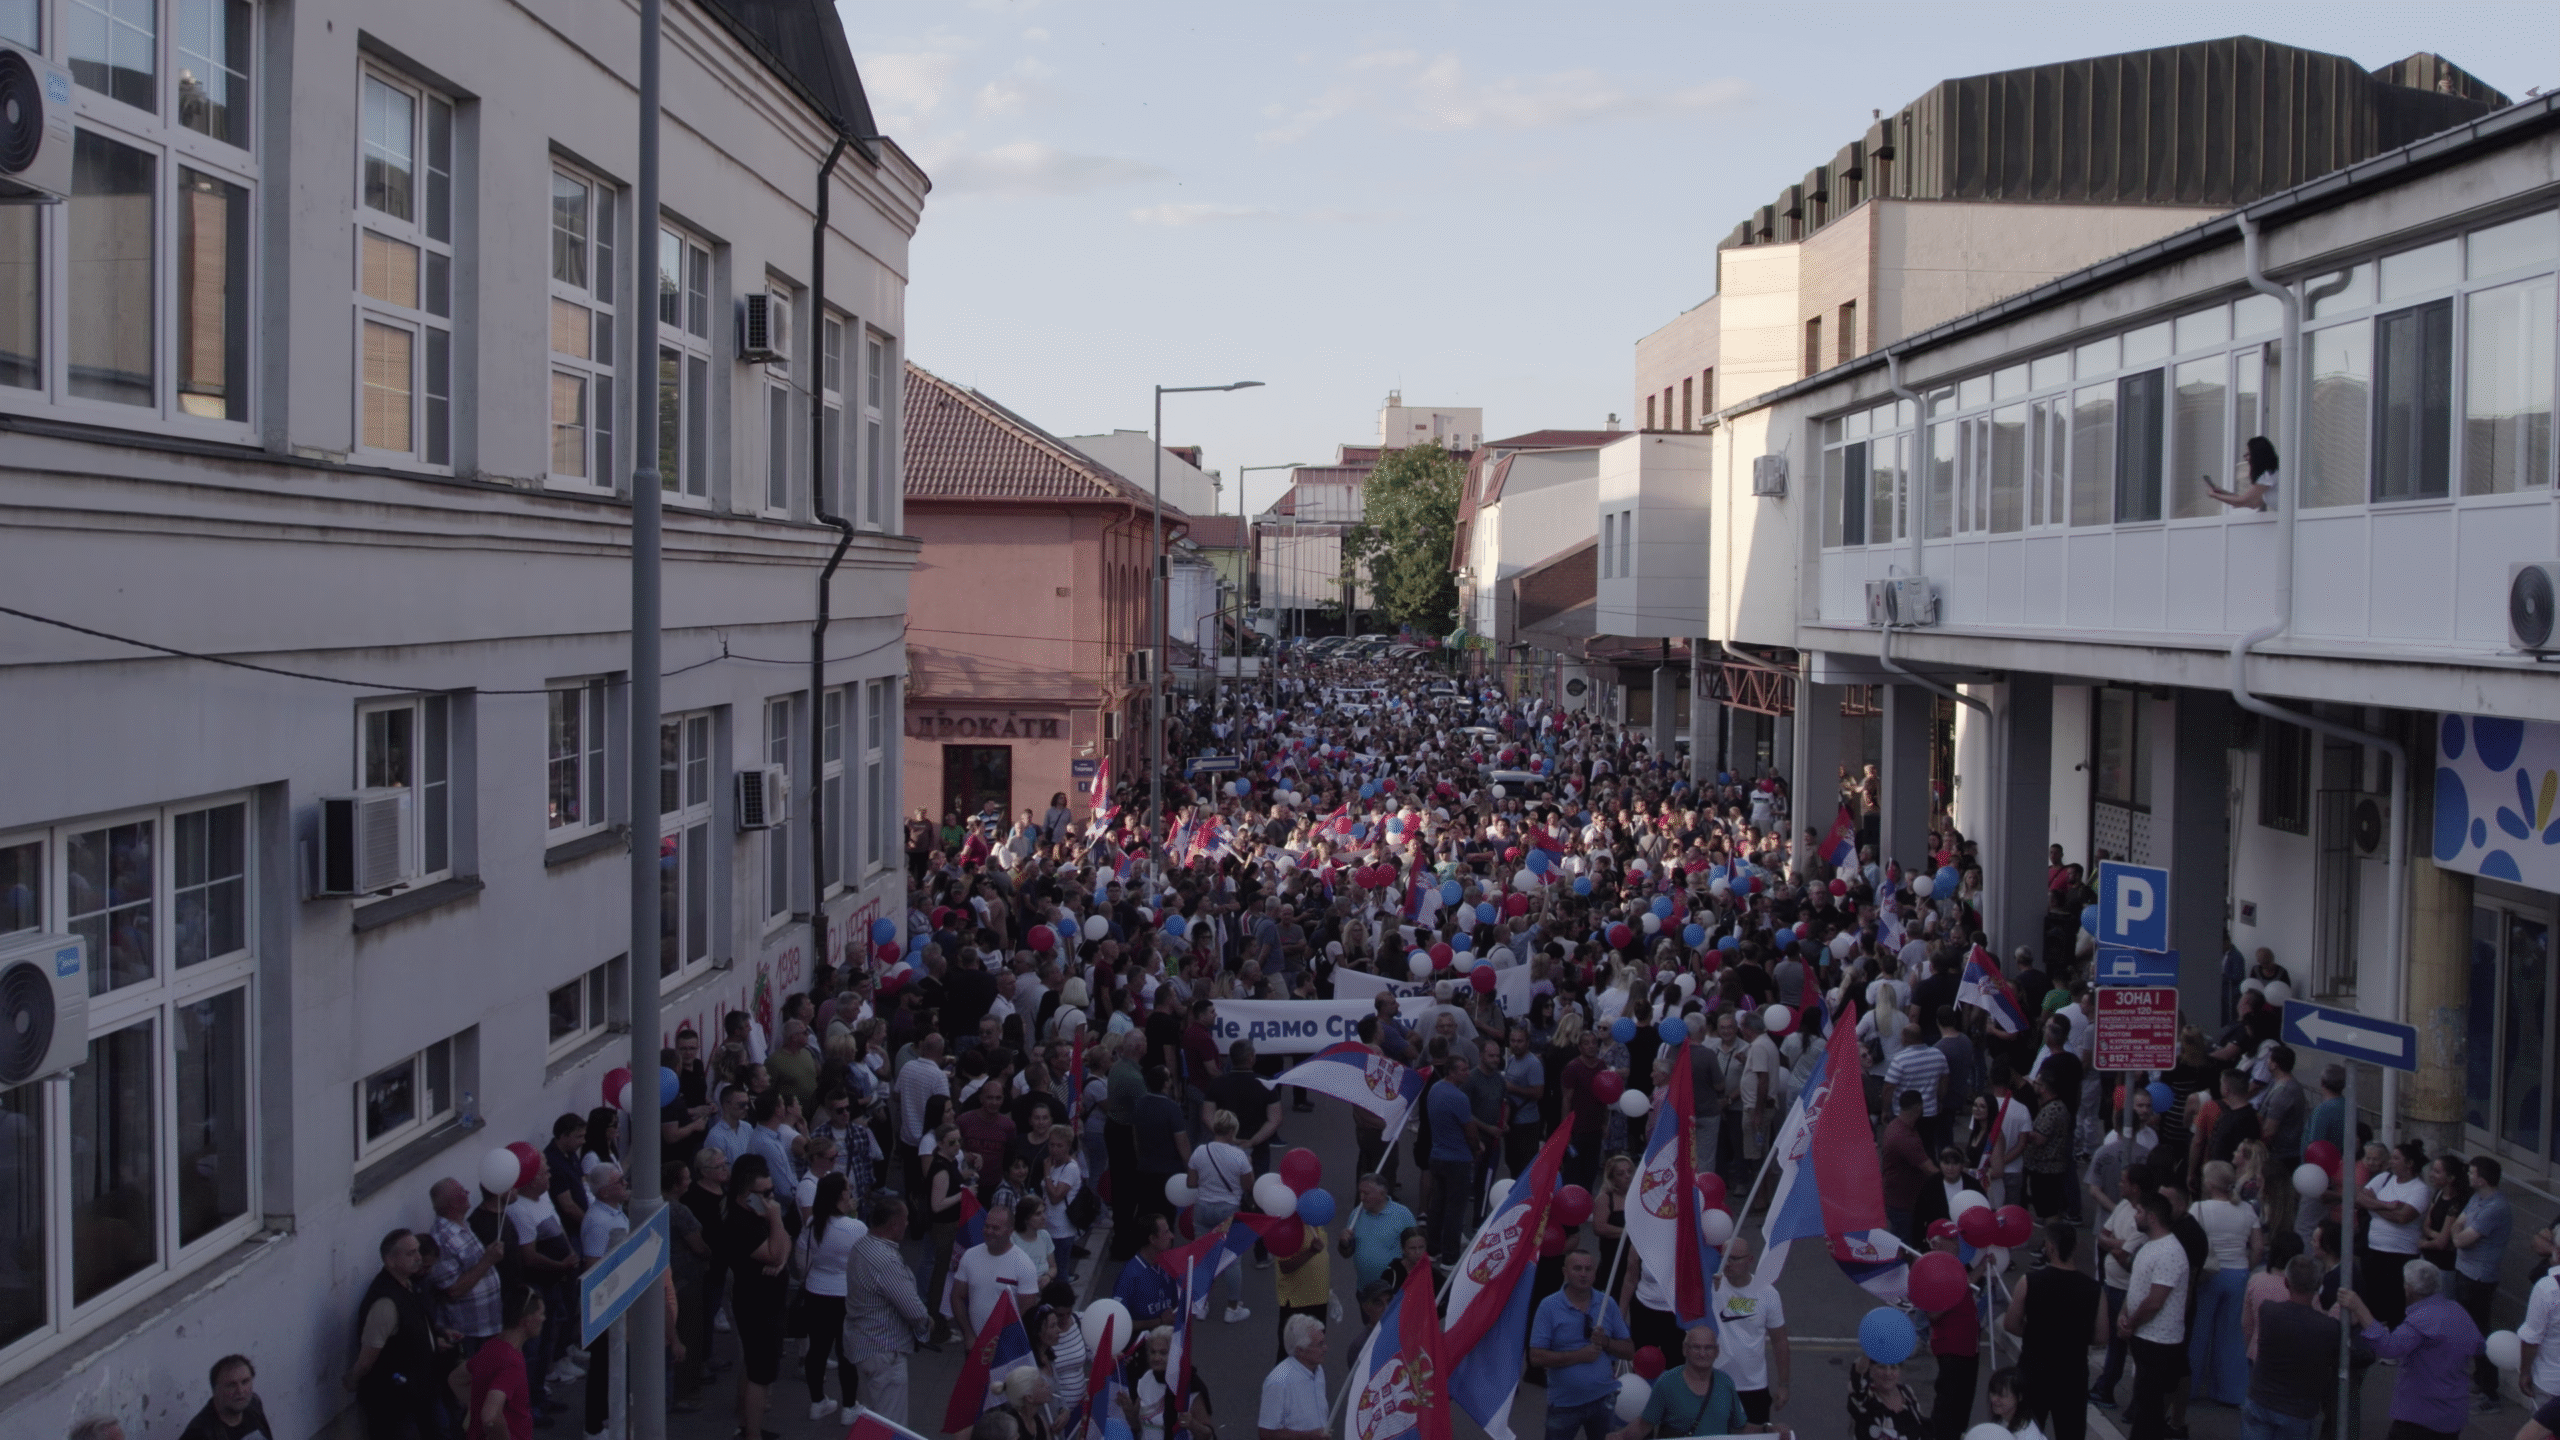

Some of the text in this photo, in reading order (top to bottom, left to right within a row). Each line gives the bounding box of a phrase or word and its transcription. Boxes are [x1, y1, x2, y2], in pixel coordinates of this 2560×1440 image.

[2116, 874, 2154, 936] P
[2115, 991, 2152, 1006] ЗОНА
[2137, 1006, 2152, 1015] 120
[1211, 1017, 1240, 1038] Не
[1248, 1020, 1318, 1041] дамо
[2109, 1054, 2129, 1062] 8121
